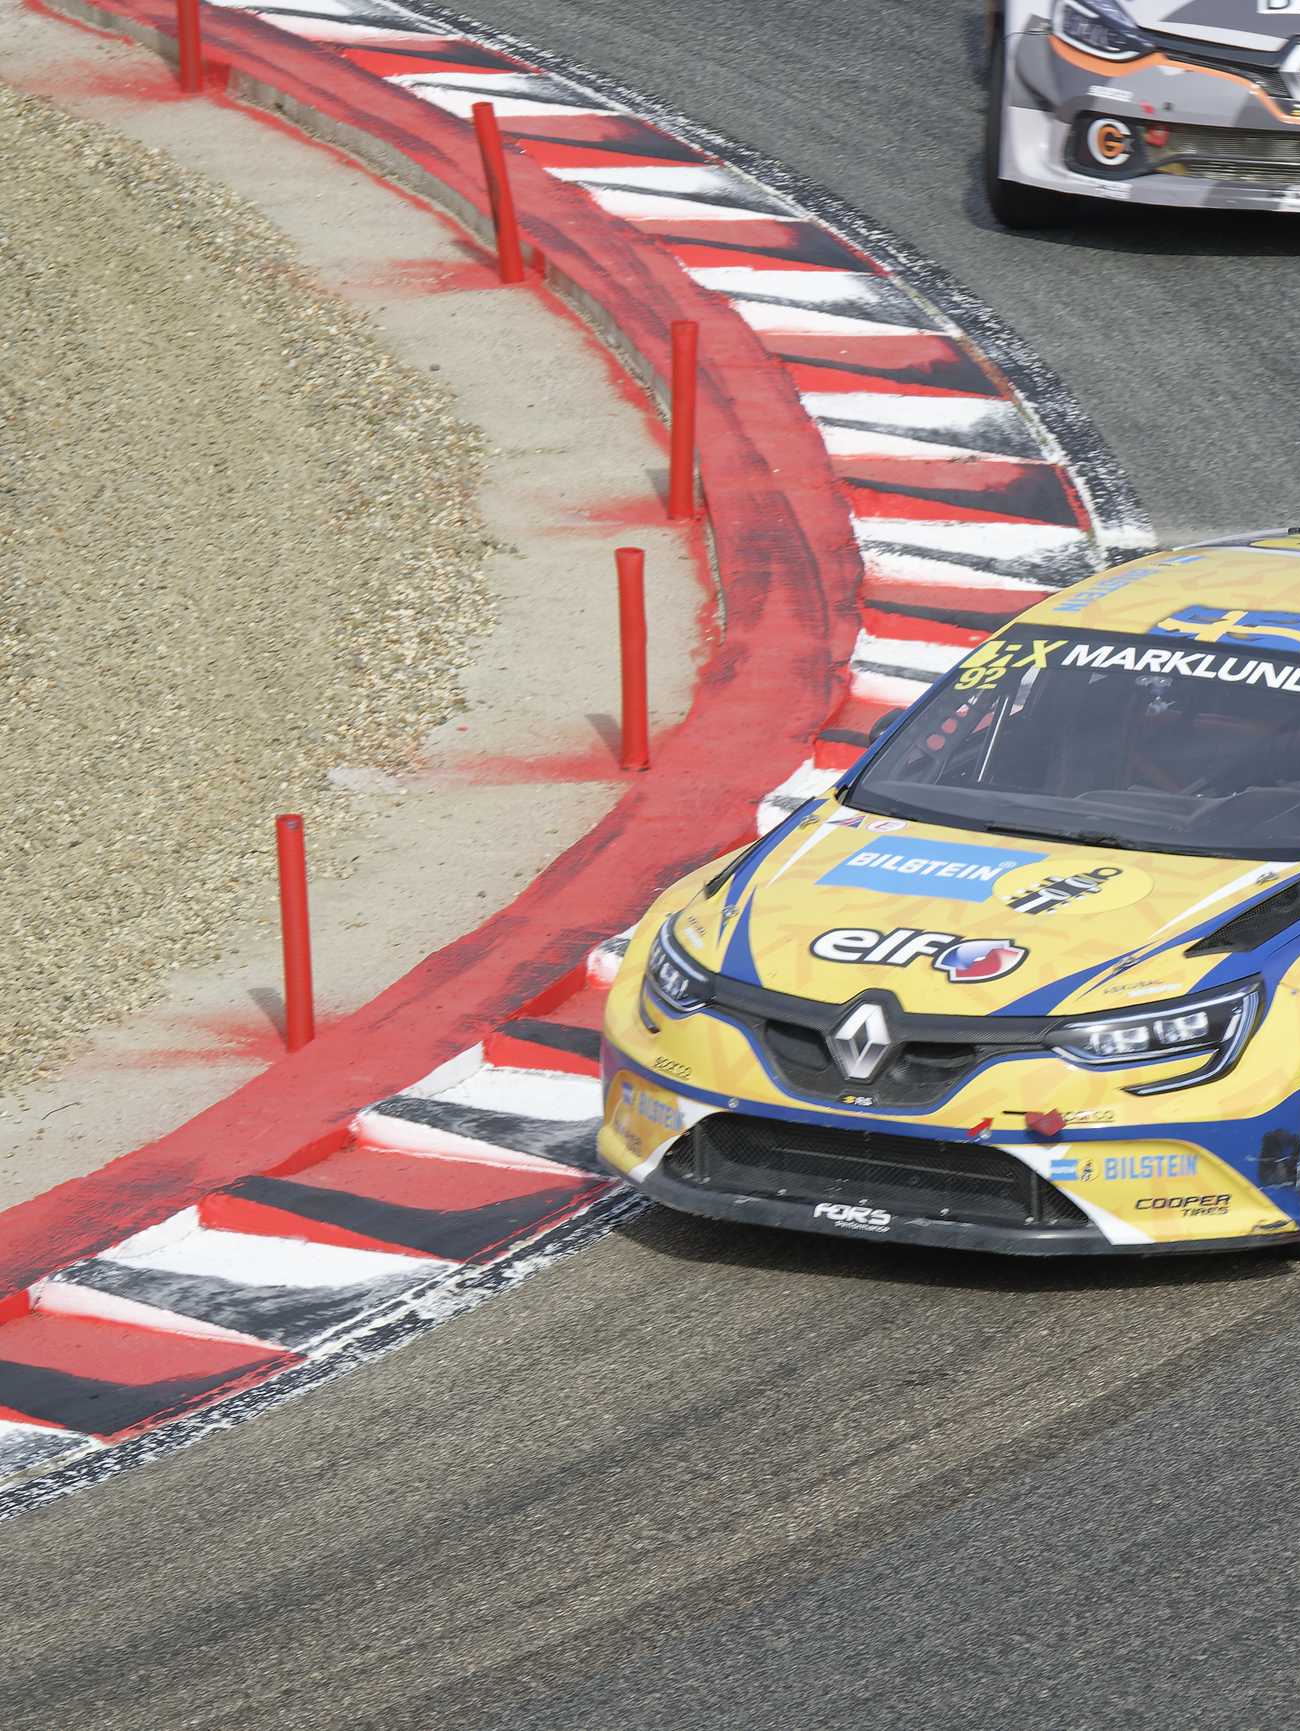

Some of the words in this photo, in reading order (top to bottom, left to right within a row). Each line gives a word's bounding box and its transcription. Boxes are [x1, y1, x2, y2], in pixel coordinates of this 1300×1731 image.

[954, 666, 1007, 691] 92
[847, 851, 1003, 882] BILSTEIN
[811, 928, 960, 968] elf
[1104, 1153, 1199, 1182] BILSTEIN
[813, 1202, 892, 1226] FORS
[1135, 1194, 1233, 1211] COOPER
[1181, 1206, 1230, 1218] TIRES
